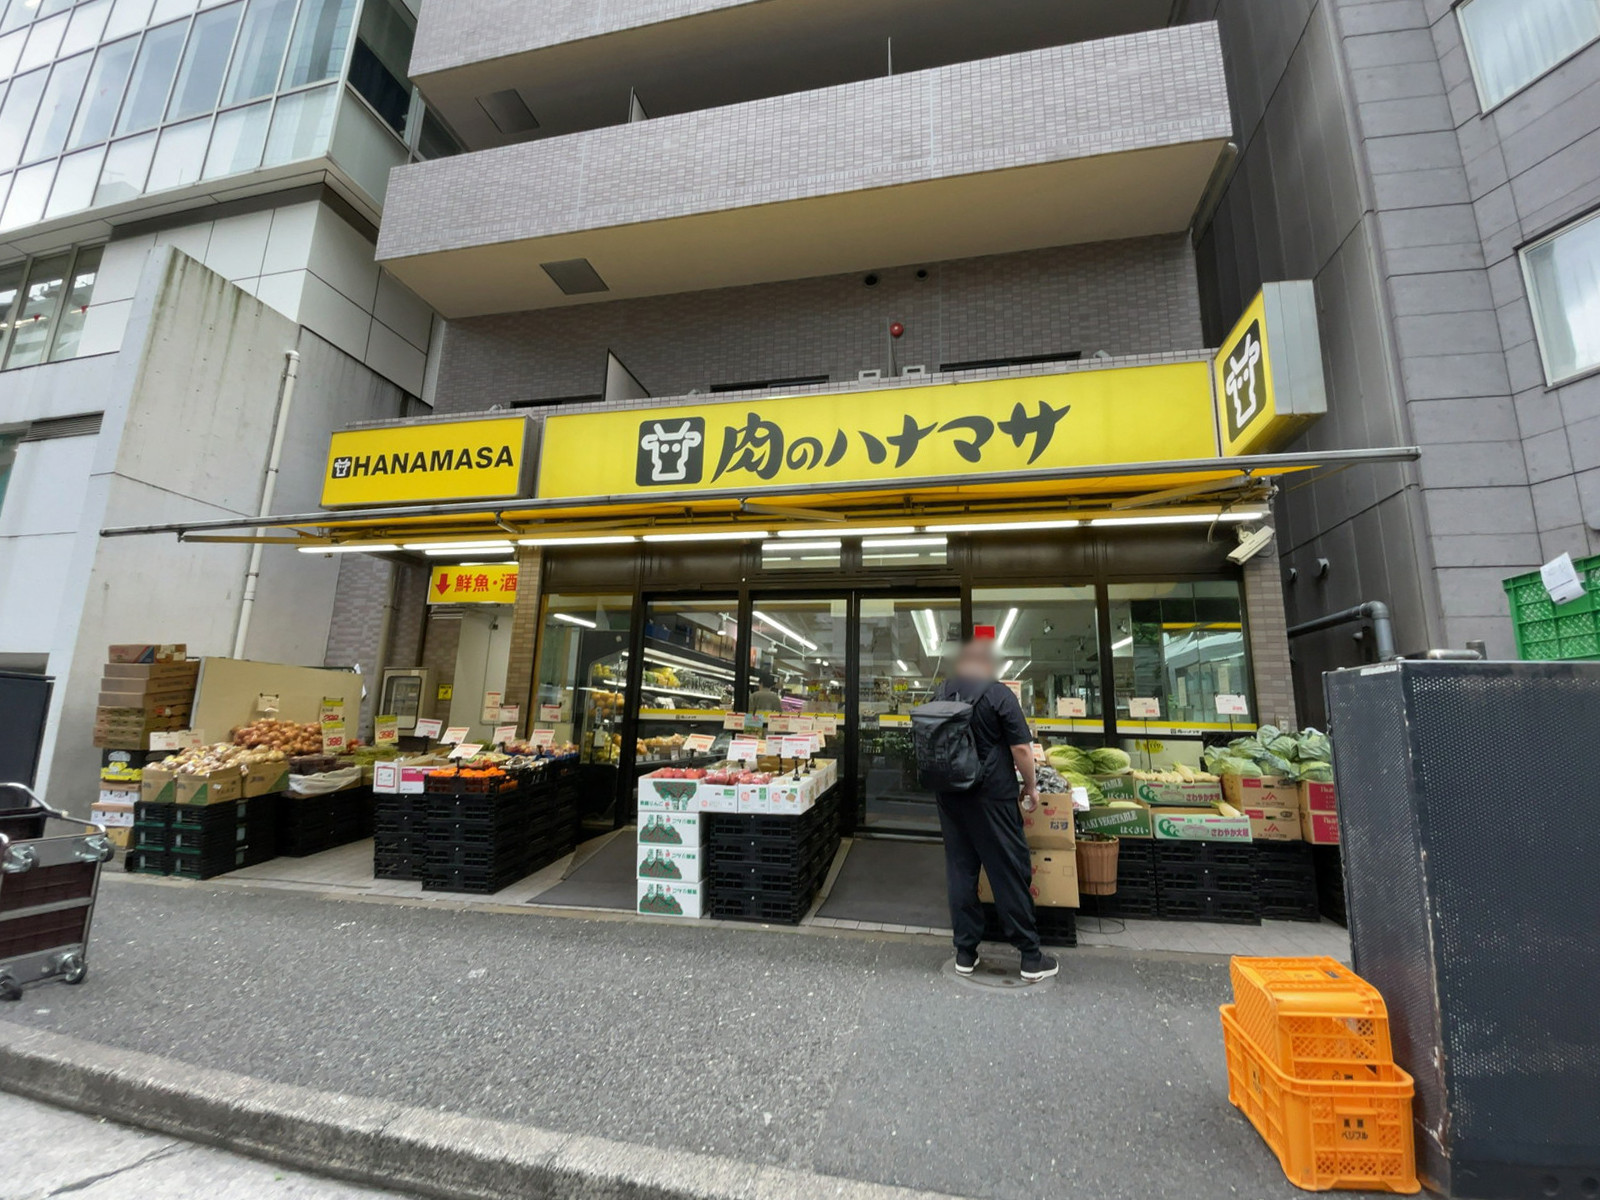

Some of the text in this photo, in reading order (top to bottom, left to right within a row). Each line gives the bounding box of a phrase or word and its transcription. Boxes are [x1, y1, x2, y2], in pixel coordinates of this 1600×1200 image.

[710, 400, 1071, 484] 肉のハナマサ
[352, 446, 514, 477] HANAMASA
[454, 573, 518, 592] 鮮魚・酒
